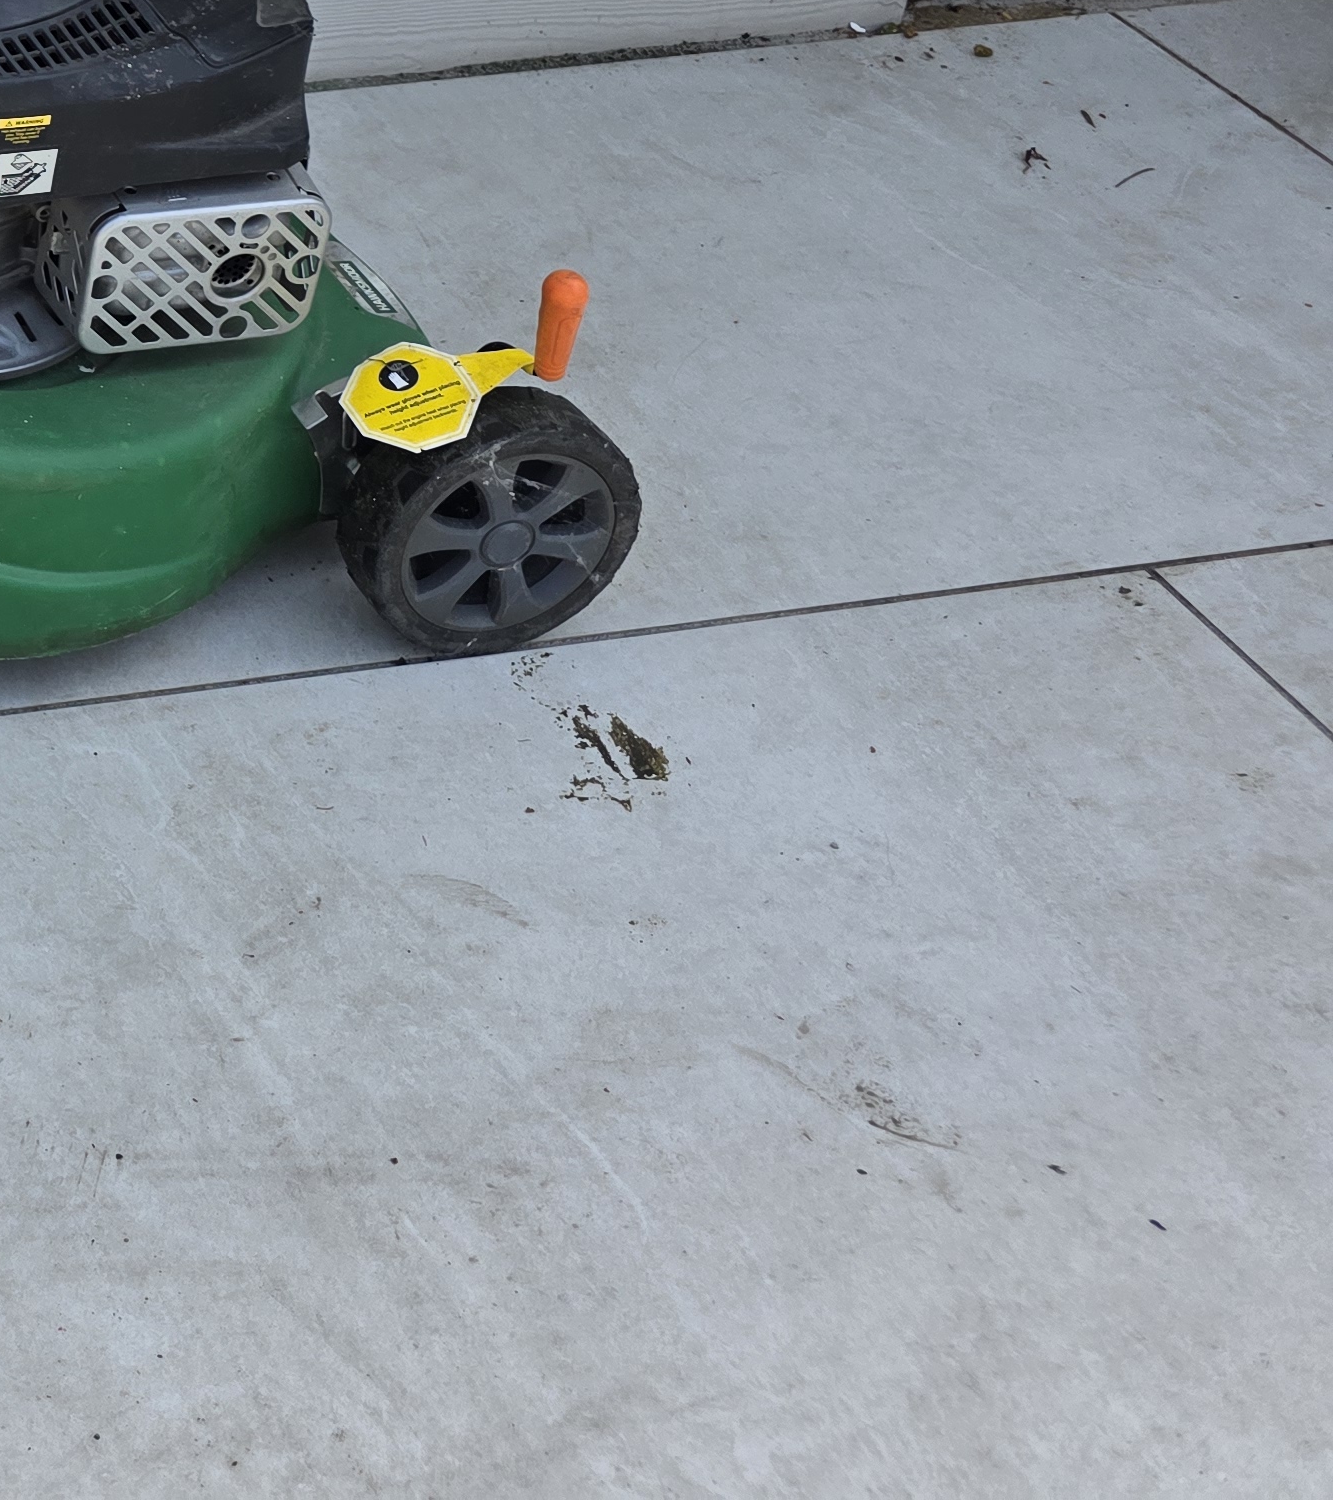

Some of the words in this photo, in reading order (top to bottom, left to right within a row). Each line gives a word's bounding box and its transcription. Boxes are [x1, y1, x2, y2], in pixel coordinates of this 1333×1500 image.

[339, 262, 392, 311] HAWKSMOOR
[364, 407, 386, 418] Always
[386, 401, 400, 409] wear
[401, 394, 421, 404] gloves
[421, 387, 438, 396] when
[438, 380, 462, 391] placing
[389, 404, 409, 415] height
